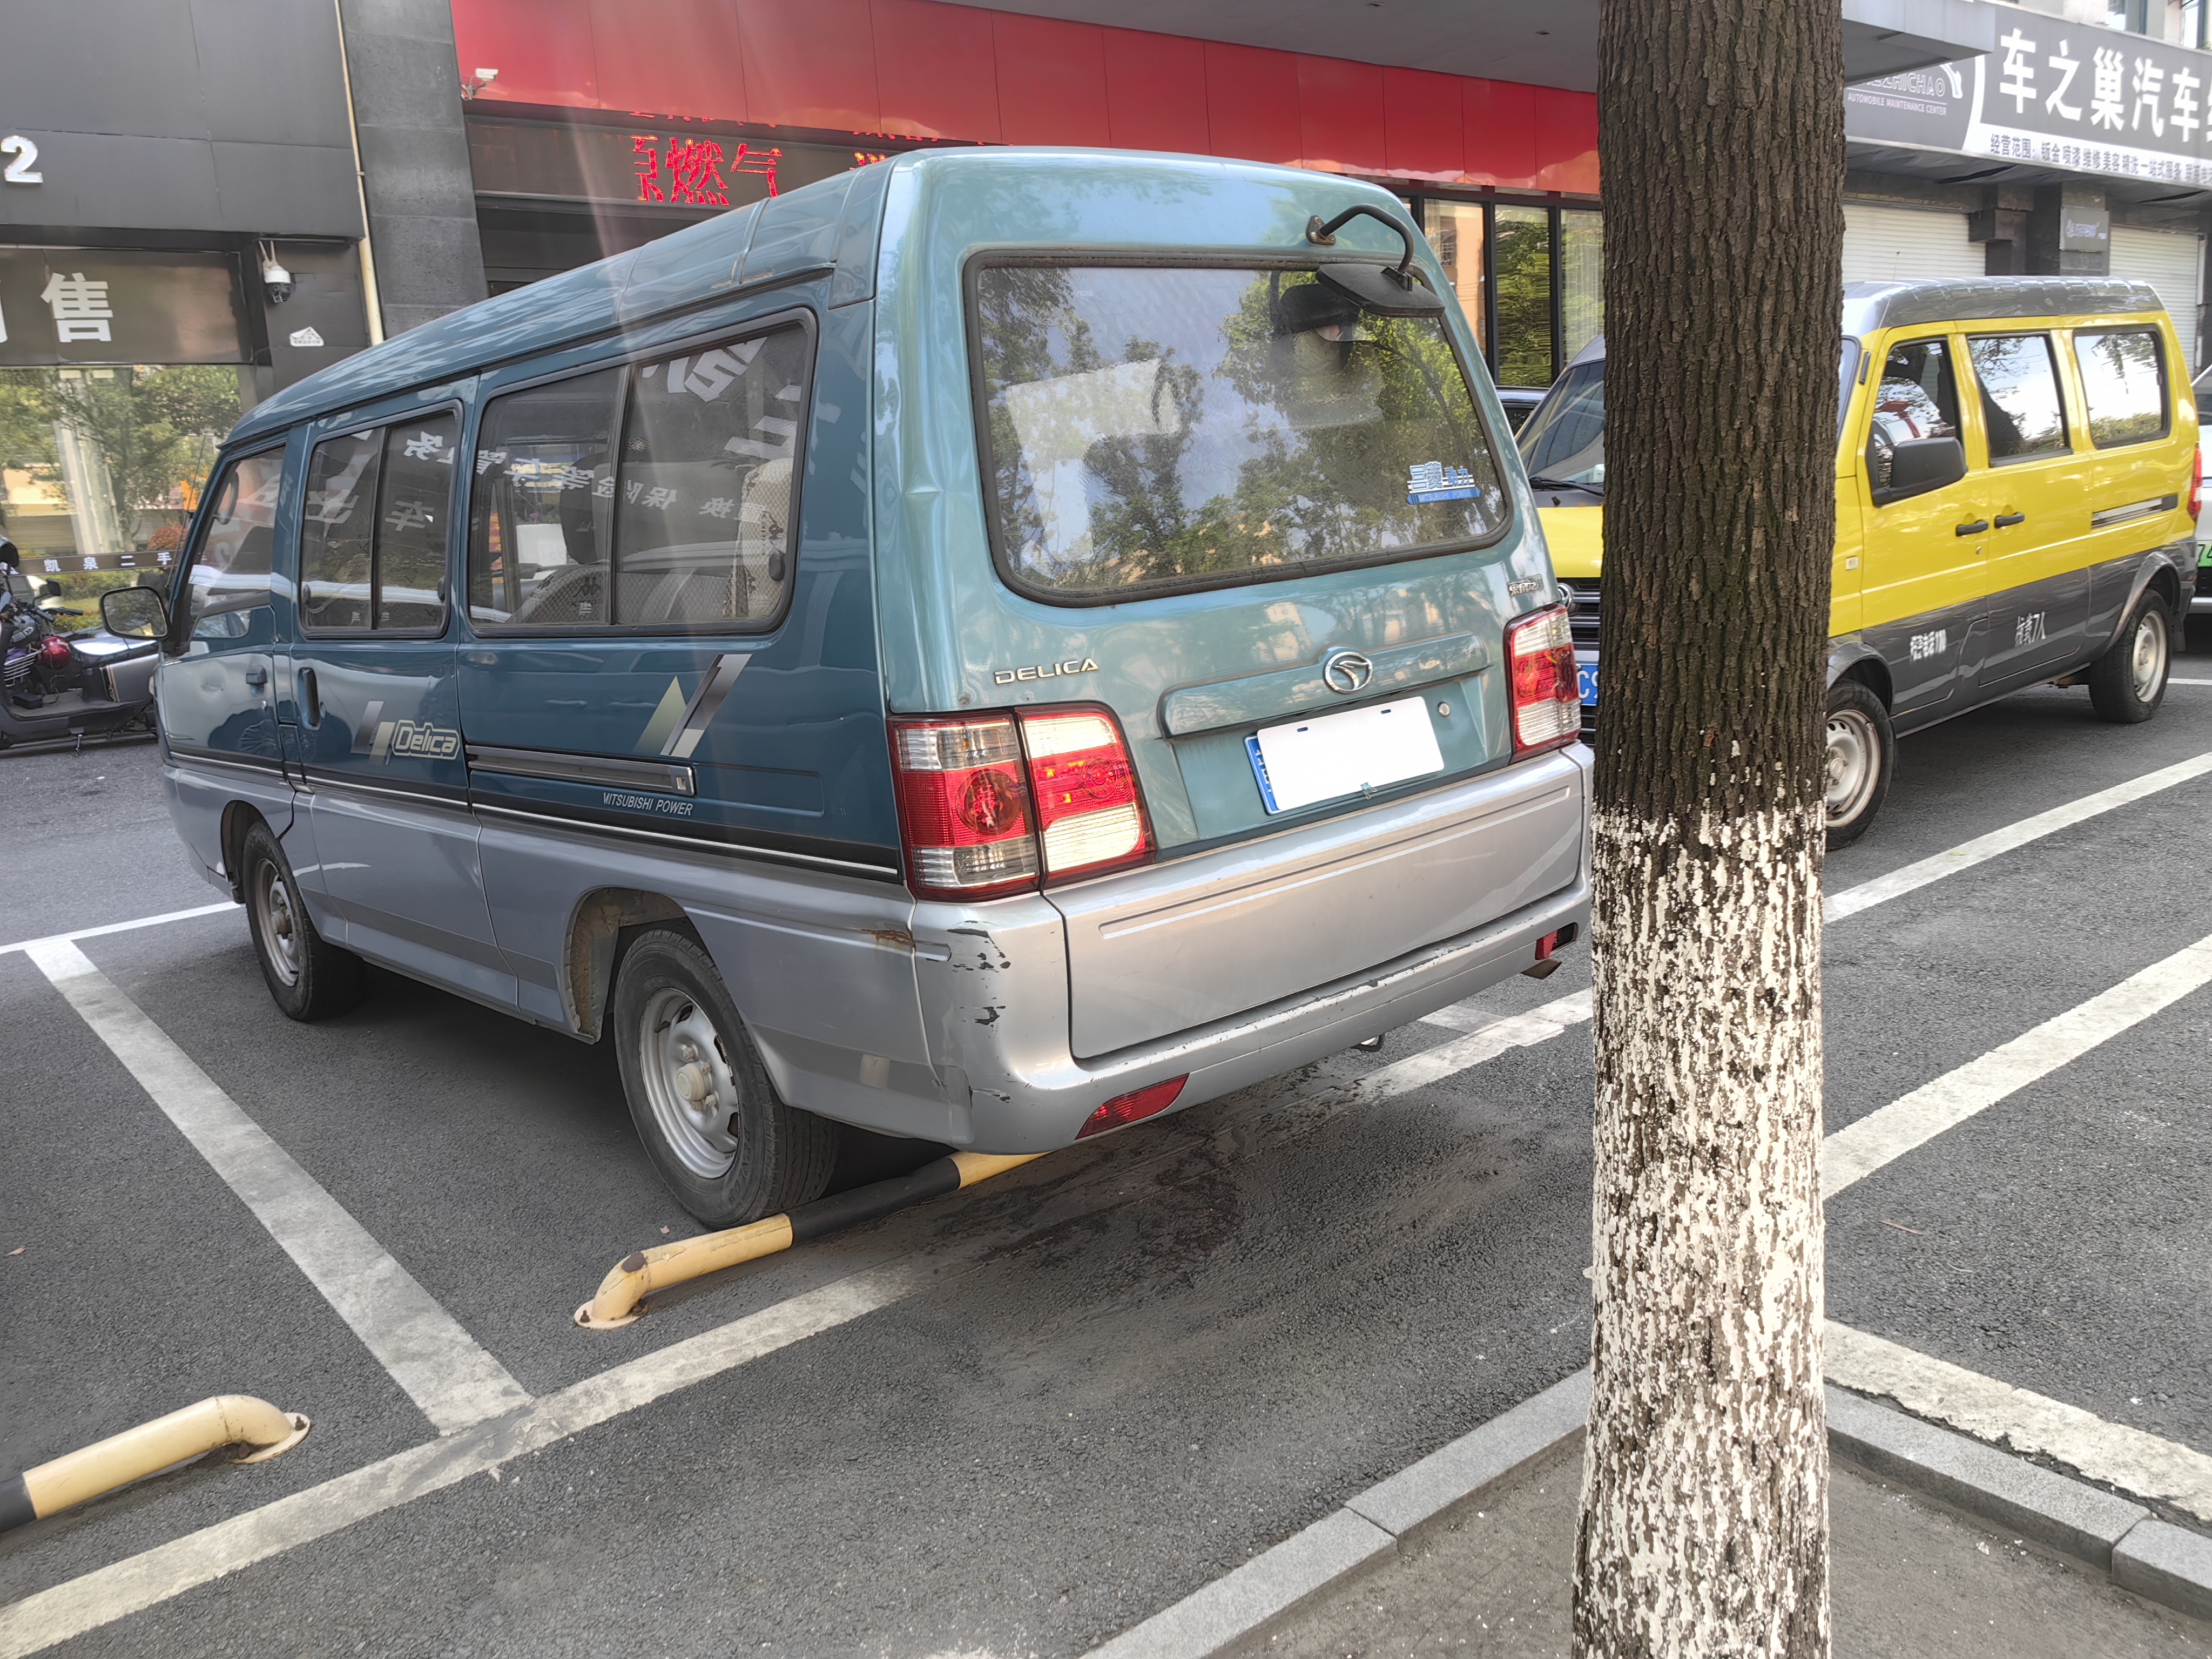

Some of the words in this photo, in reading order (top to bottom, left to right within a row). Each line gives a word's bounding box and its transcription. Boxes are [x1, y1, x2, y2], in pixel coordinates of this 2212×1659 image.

[2000, 28, 2212, 143] 车之巢汽车
[1847, 92, 1885, 106] AUTOMOBILE
[1886, 99, 1925, 113] MAINTENANCE
[1926, 104, 1946, 116] CENTER
[1, 135, 43, 183] 2
[0, 273, 113, 342] 售
[995, 658, 1099, 684] DELICA
[395, 726, 457, 753] Delica
[603, 792, 654, 810] MITSUBISHI
[656, 799, 693, 815] POWER
